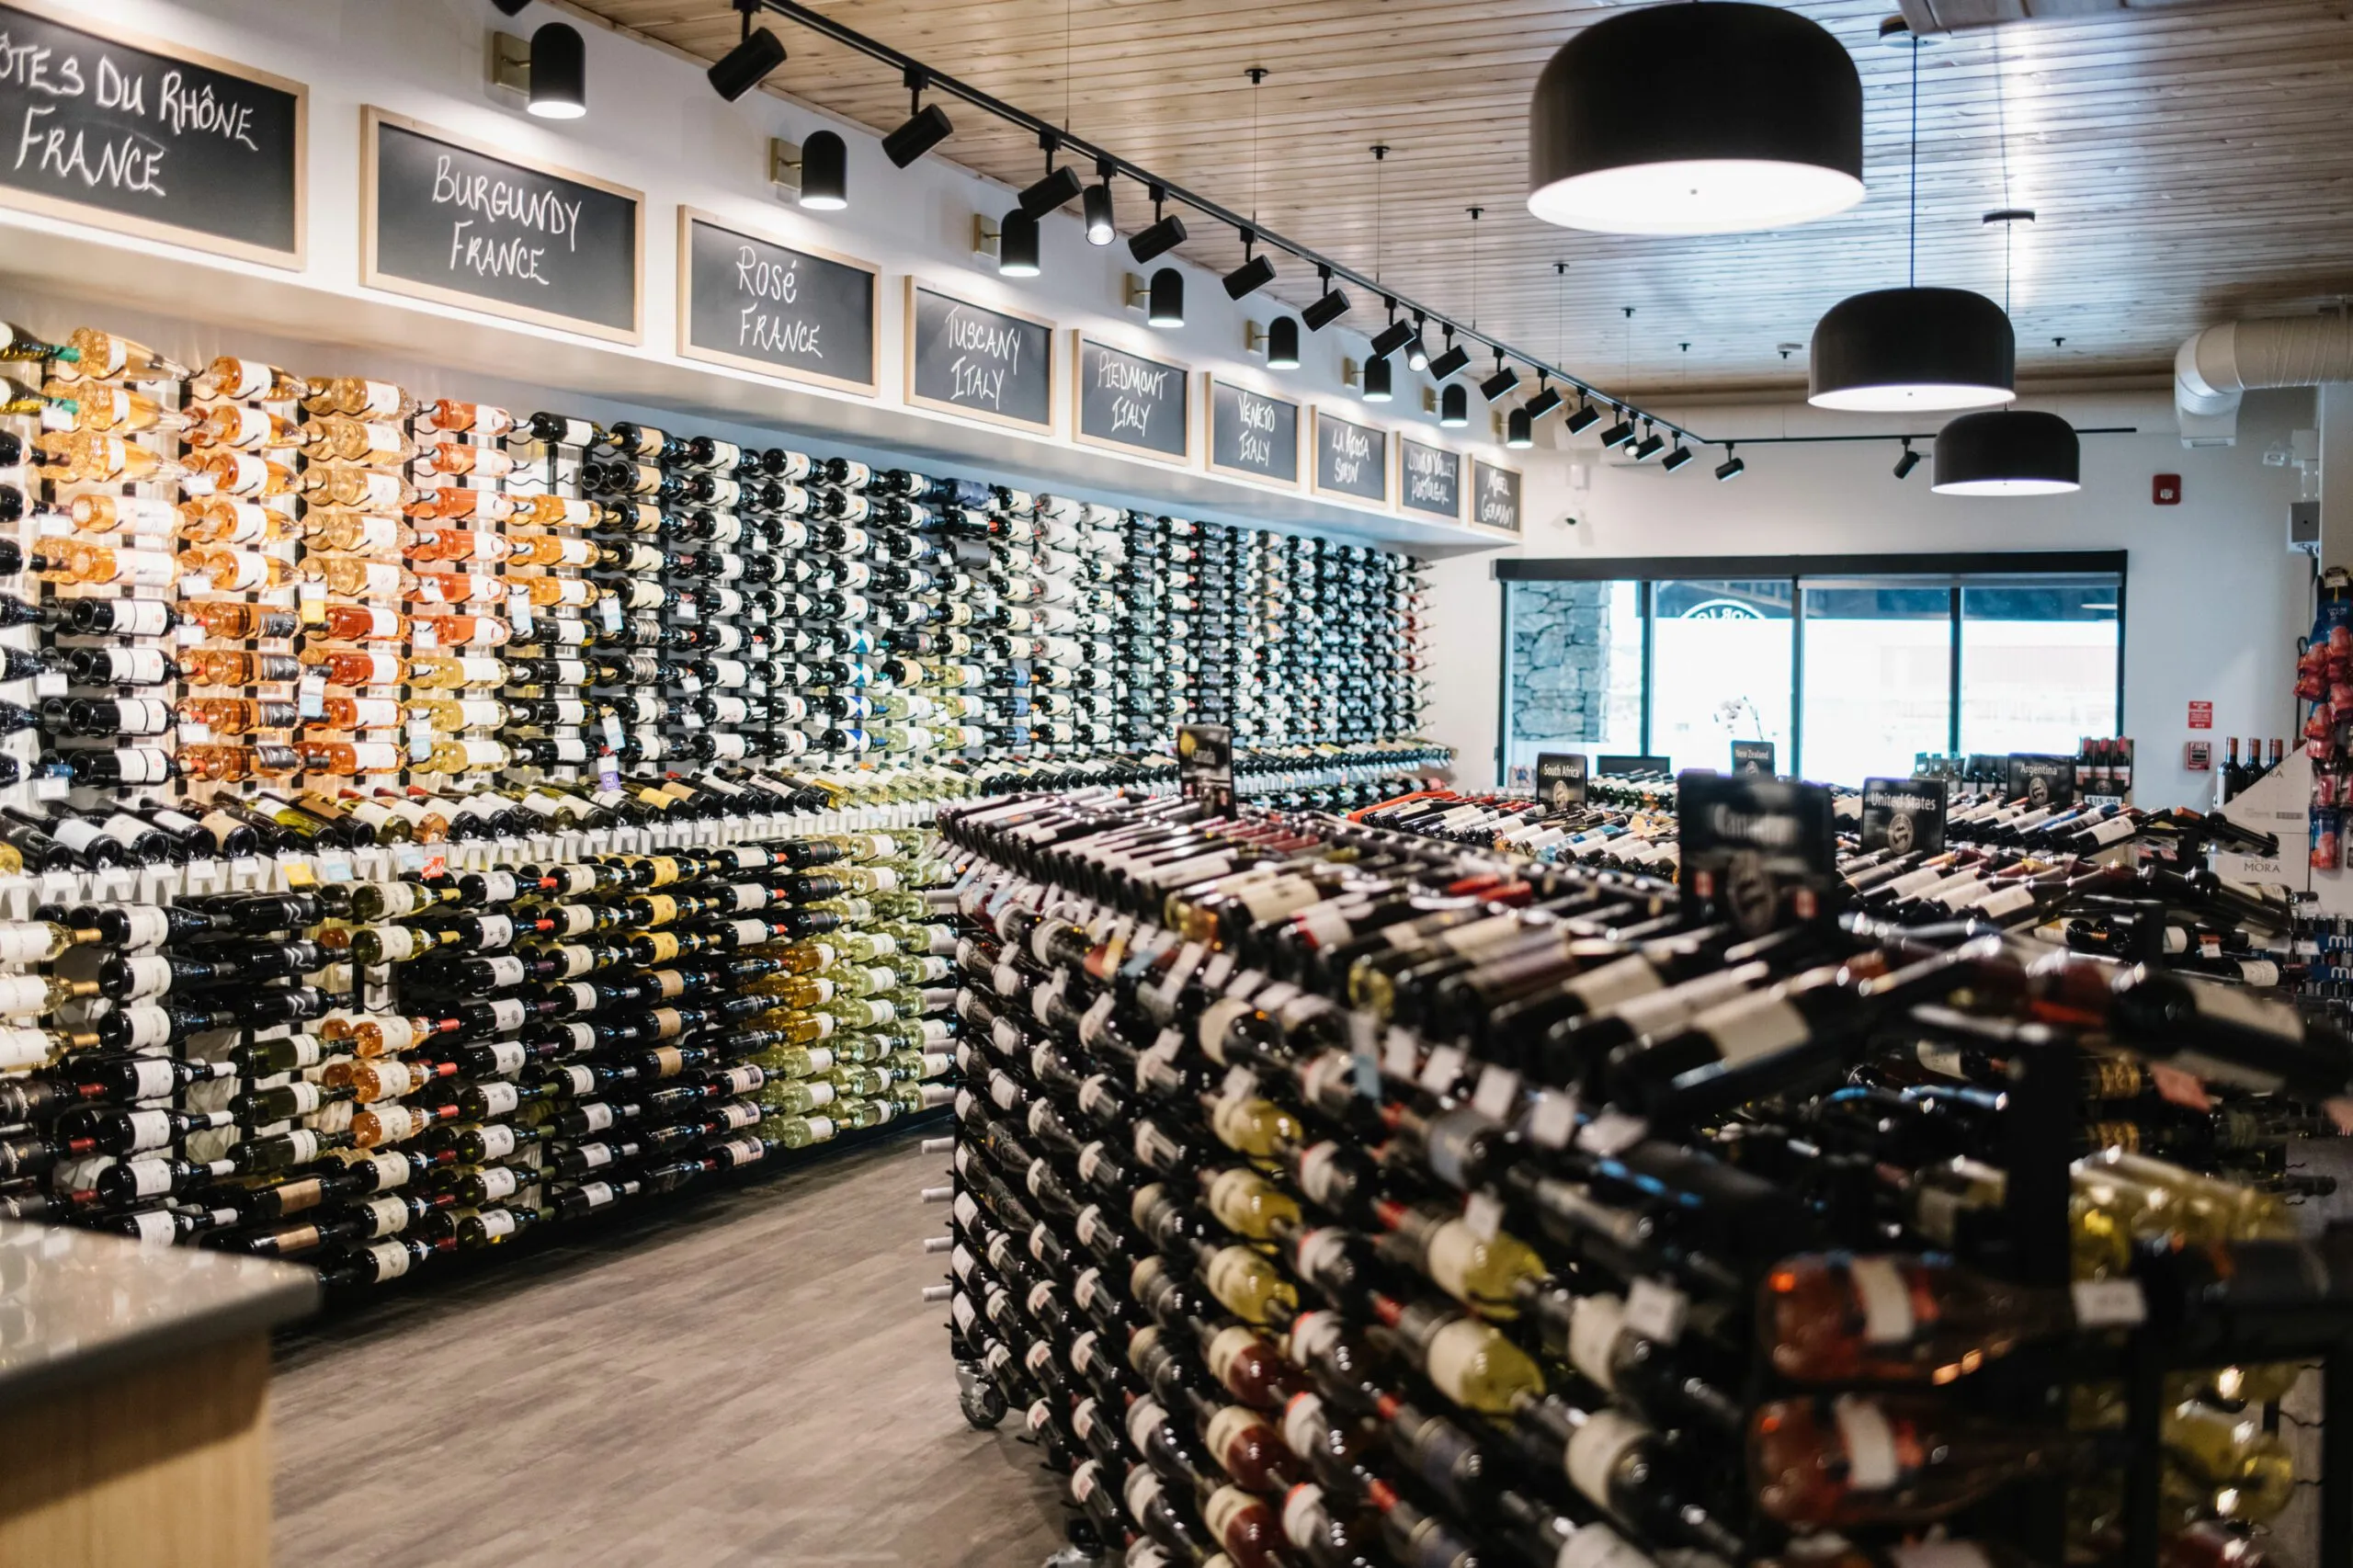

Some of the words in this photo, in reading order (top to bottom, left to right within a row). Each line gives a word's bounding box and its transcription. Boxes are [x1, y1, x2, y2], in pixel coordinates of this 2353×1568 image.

[159, 69, 259, 152] RHÔNE
[14, 104, 166, 197] FRANCE
[432, 154, 582, 253] BURGUNDY
[449, 220, 550, 286] FRANCE
[739, 301, 823, 358] FRANCE
[945, 304, 1021, 376] TUSCANY
[949, 355, 1005, 411] ITALY
[1097, 350, 1168, 401] PIEDMONT
[1110, 395, 1152, 437] ITALY
[1237, 392, 1276, 433] VENETO
[1238, 429, 1271, 467] ITALY
[1544, 764, 1562, 777] South
[1562, 765, 1580, 778] Africa
[2020, 763, 2058, 777] Argentina
[1870, 791, 1904, 808] United
[1904, 793, 1937, 811] States
[2244, 862, 2280, 873] MORA
